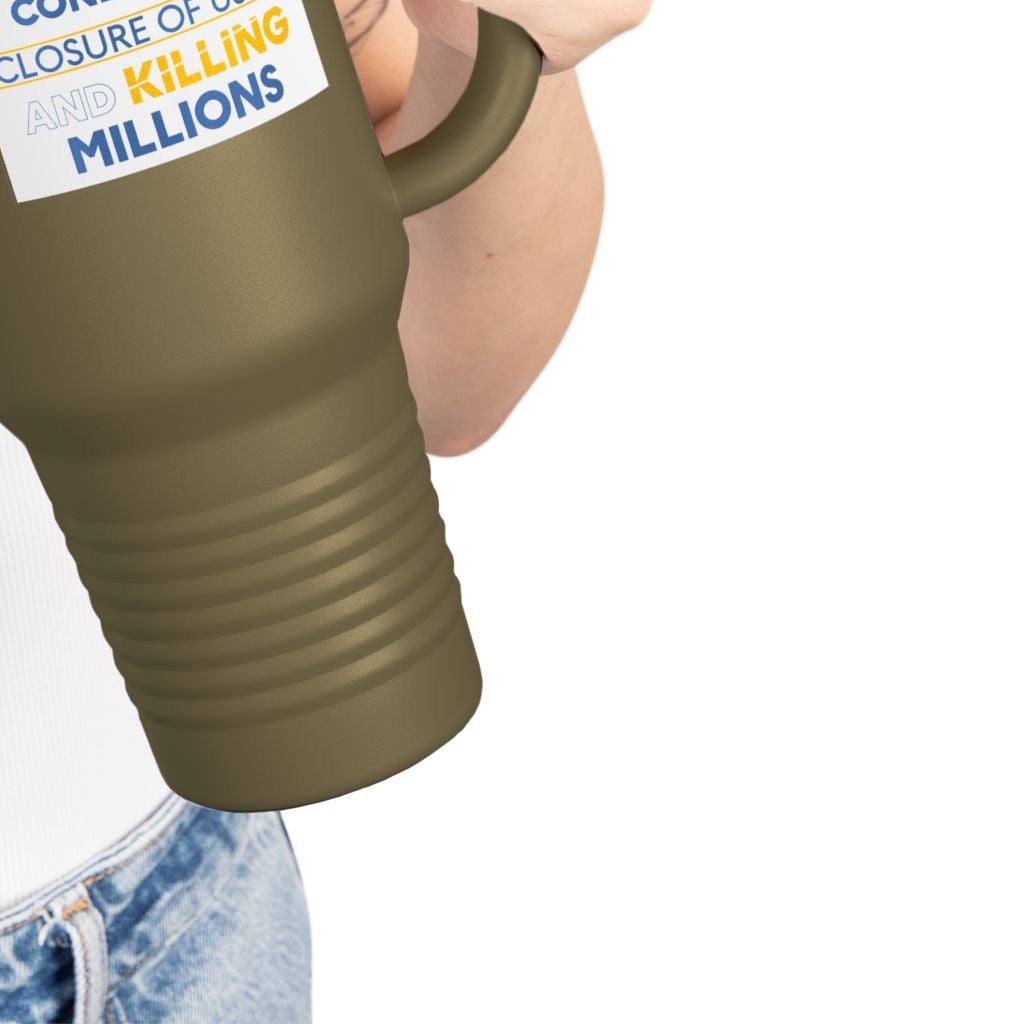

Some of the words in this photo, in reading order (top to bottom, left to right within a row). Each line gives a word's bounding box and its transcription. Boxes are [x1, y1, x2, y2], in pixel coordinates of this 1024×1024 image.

[26, 83, 116, 135] AND
[123, 6, 289, 105] KILLING
[67, 64, 285, 174] MILLIONS
